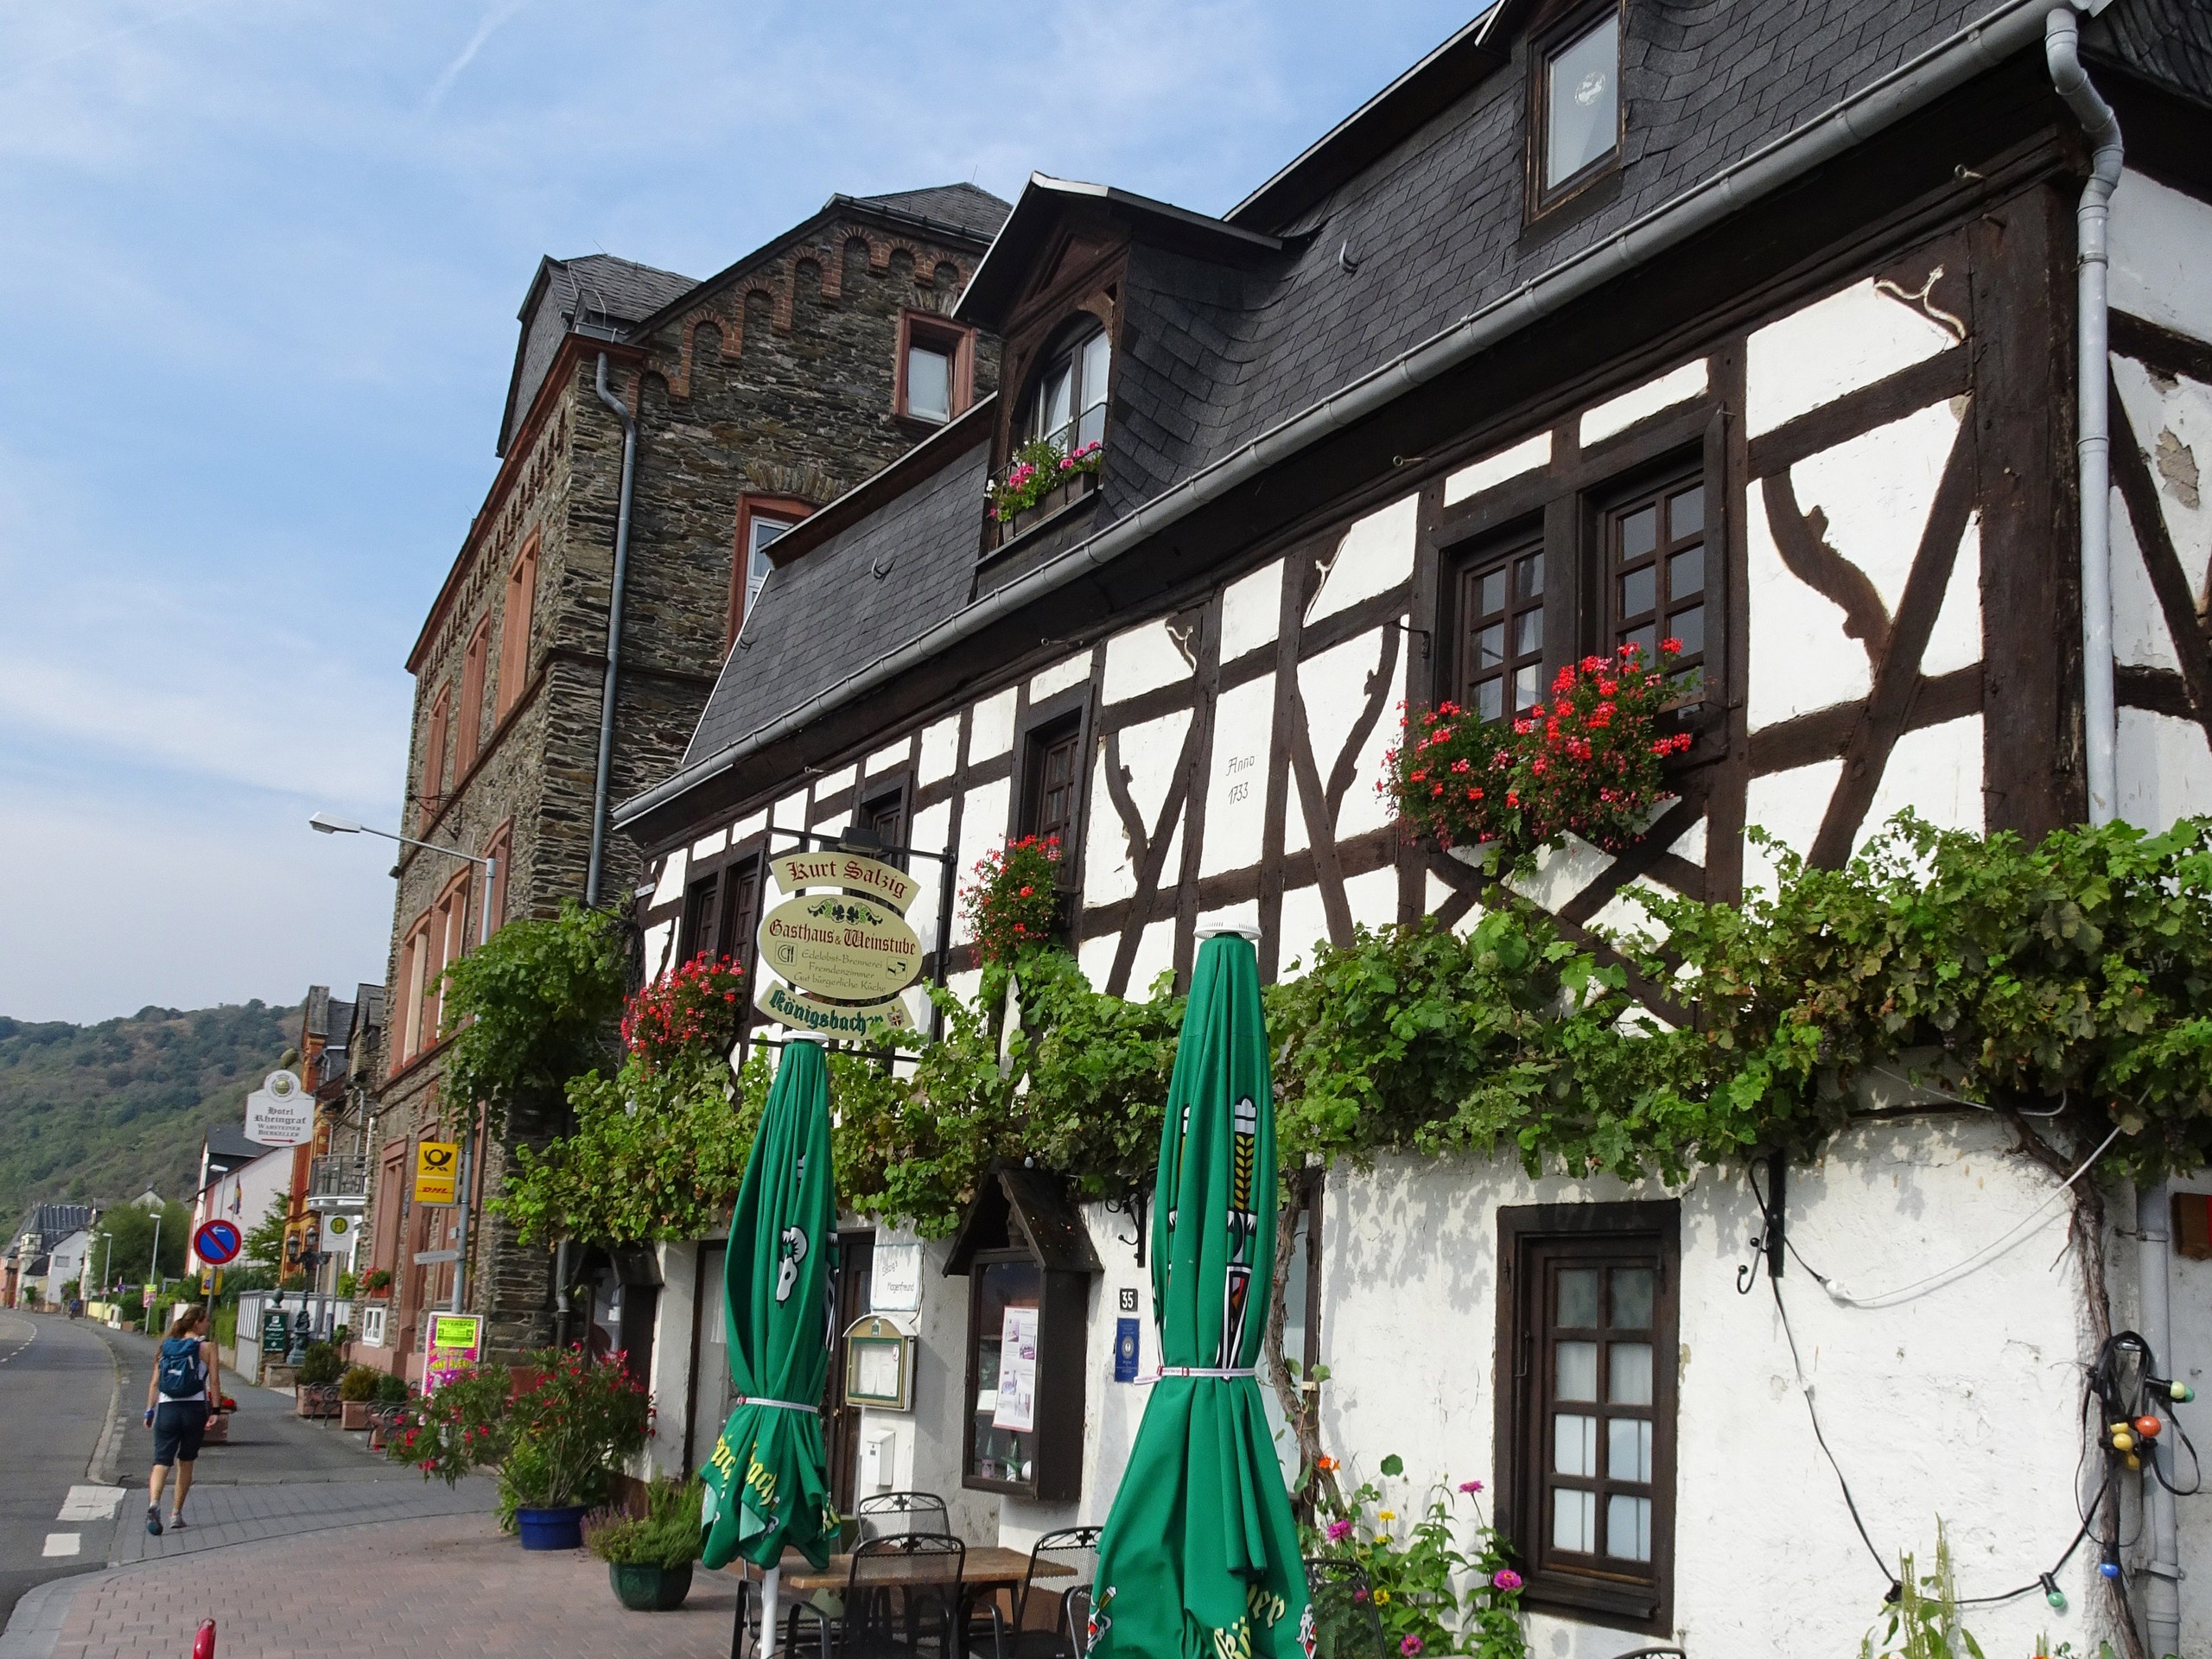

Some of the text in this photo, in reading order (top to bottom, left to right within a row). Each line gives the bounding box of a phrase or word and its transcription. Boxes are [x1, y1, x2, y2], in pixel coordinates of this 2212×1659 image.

[1225, 756, 1255, 776] Anno
[1228, 781, 1249, 804] 1733
[786, 861, 907, 899] Kurt Salzig
[769, 918, 916, 956] Gasthaus & Weinstube
[802, 949, 883, 969] Edelobst-Brennerei
[809, 962, 875, 978] Fremdenzimmer
[794, 972, 887, 994] Gut bürgerliche Küche
[254, 1115, 307, 1125] Rheingraf
[268, 1107, 294, 1116] Hotel
[1122, 1292, 1134, 1309] 35
